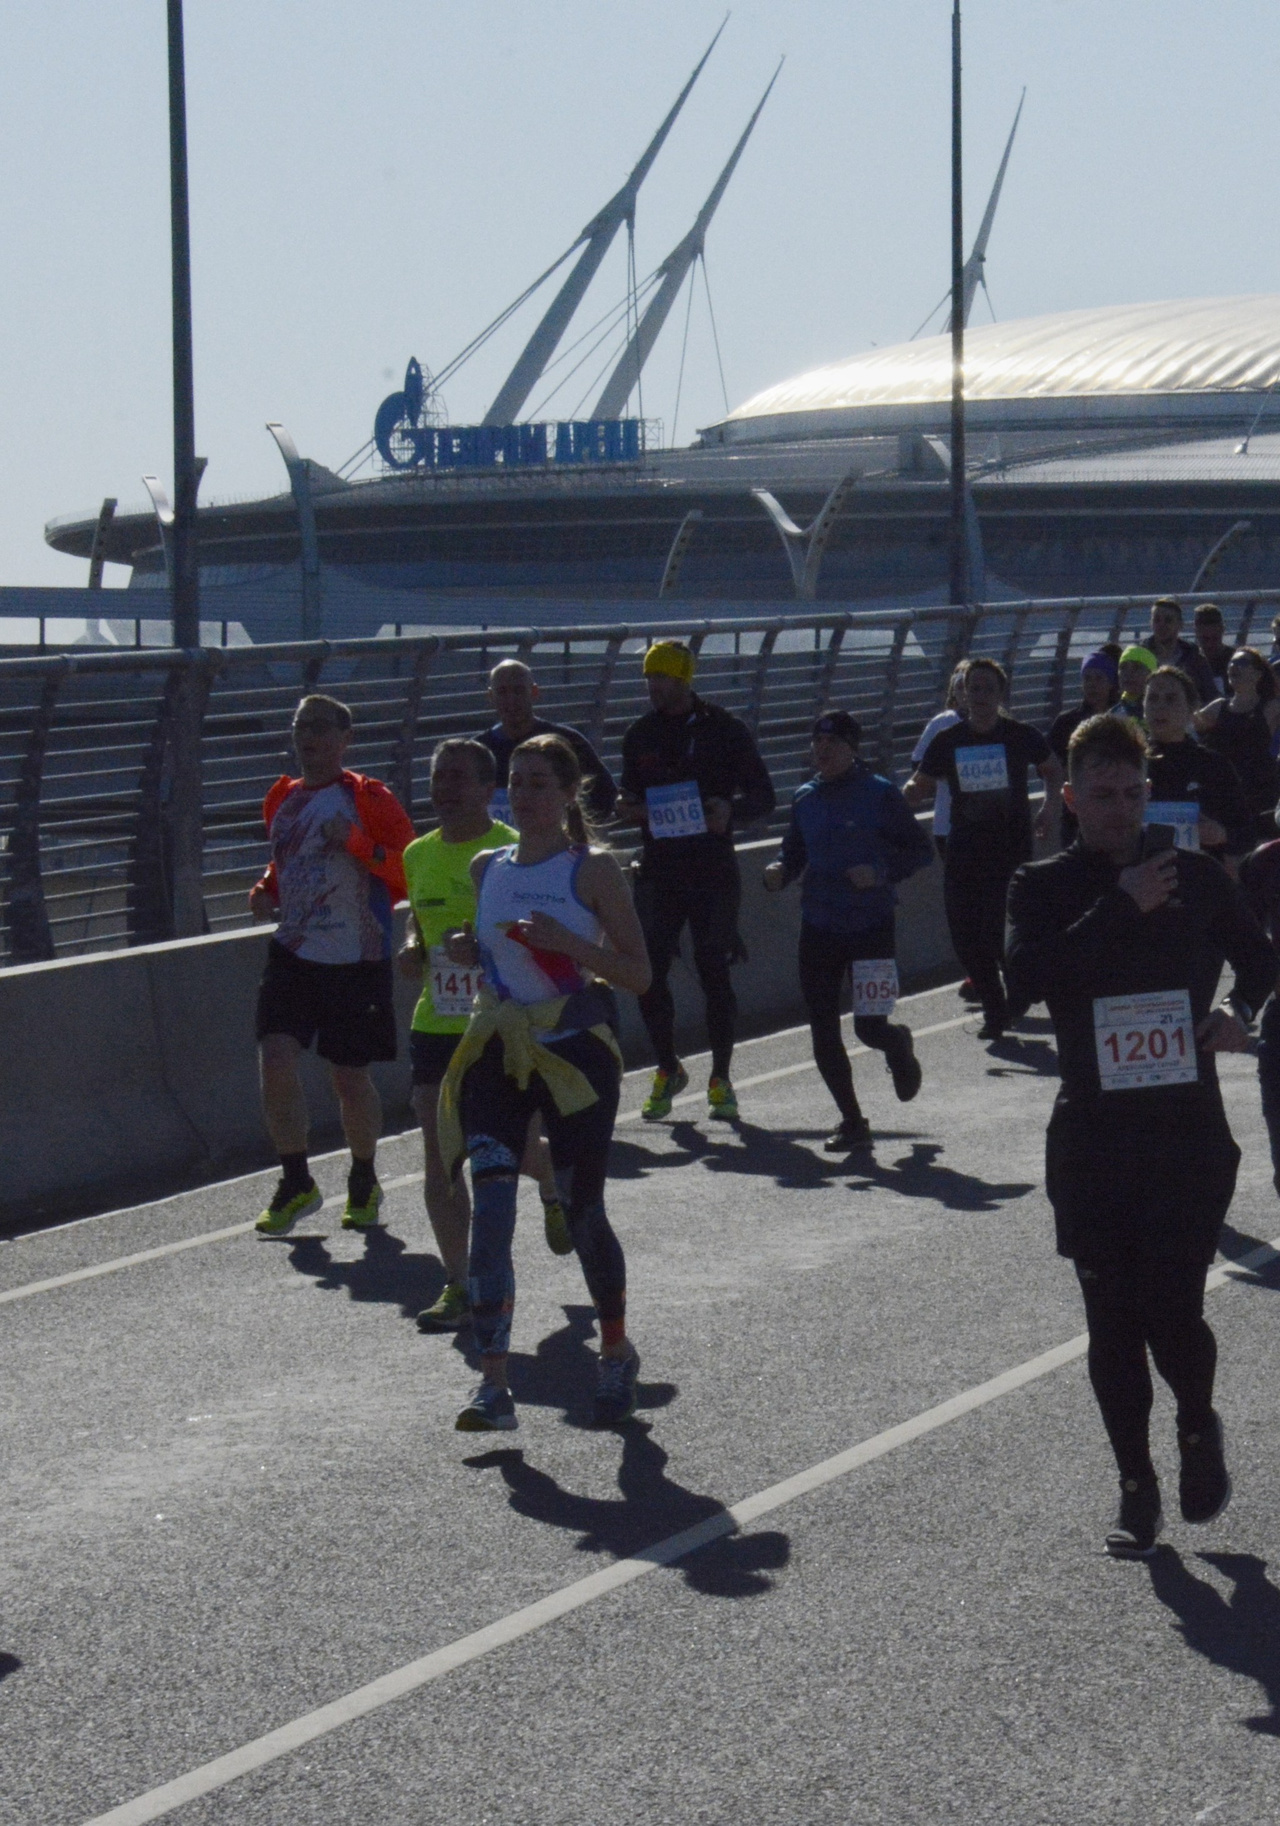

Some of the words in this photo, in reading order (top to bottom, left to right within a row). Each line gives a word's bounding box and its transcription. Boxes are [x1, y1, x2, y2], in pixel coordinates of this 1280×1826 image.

[959, 760, 1005, 779] 4044
[652, 803, 701, 826] 9016
[1160, 1014, 1173, 1024] 21
[1104, 1025, 1186, 1064] 1201
